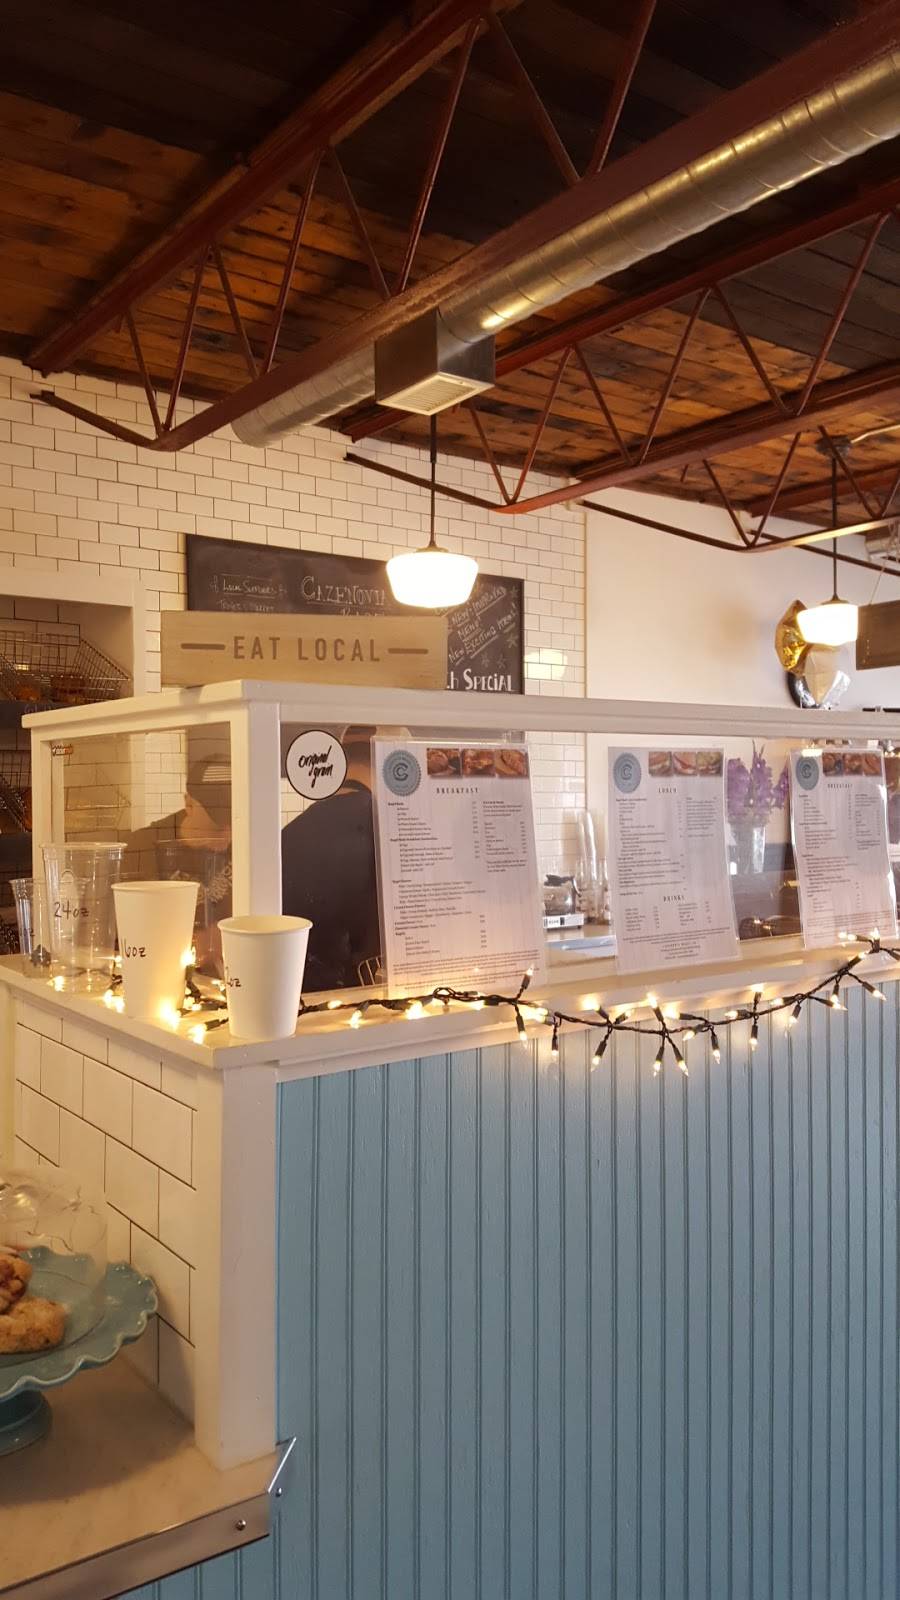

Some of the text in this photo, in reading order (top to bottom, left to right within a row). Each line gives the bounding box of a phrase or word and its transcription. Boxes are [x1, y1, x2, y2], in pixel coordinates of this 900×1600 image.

[233, 635, 381, 662] EAT LOCAL
[436, 786, 479, 794] BREAKFAST
[54, 900, 90, 920] 24oz
